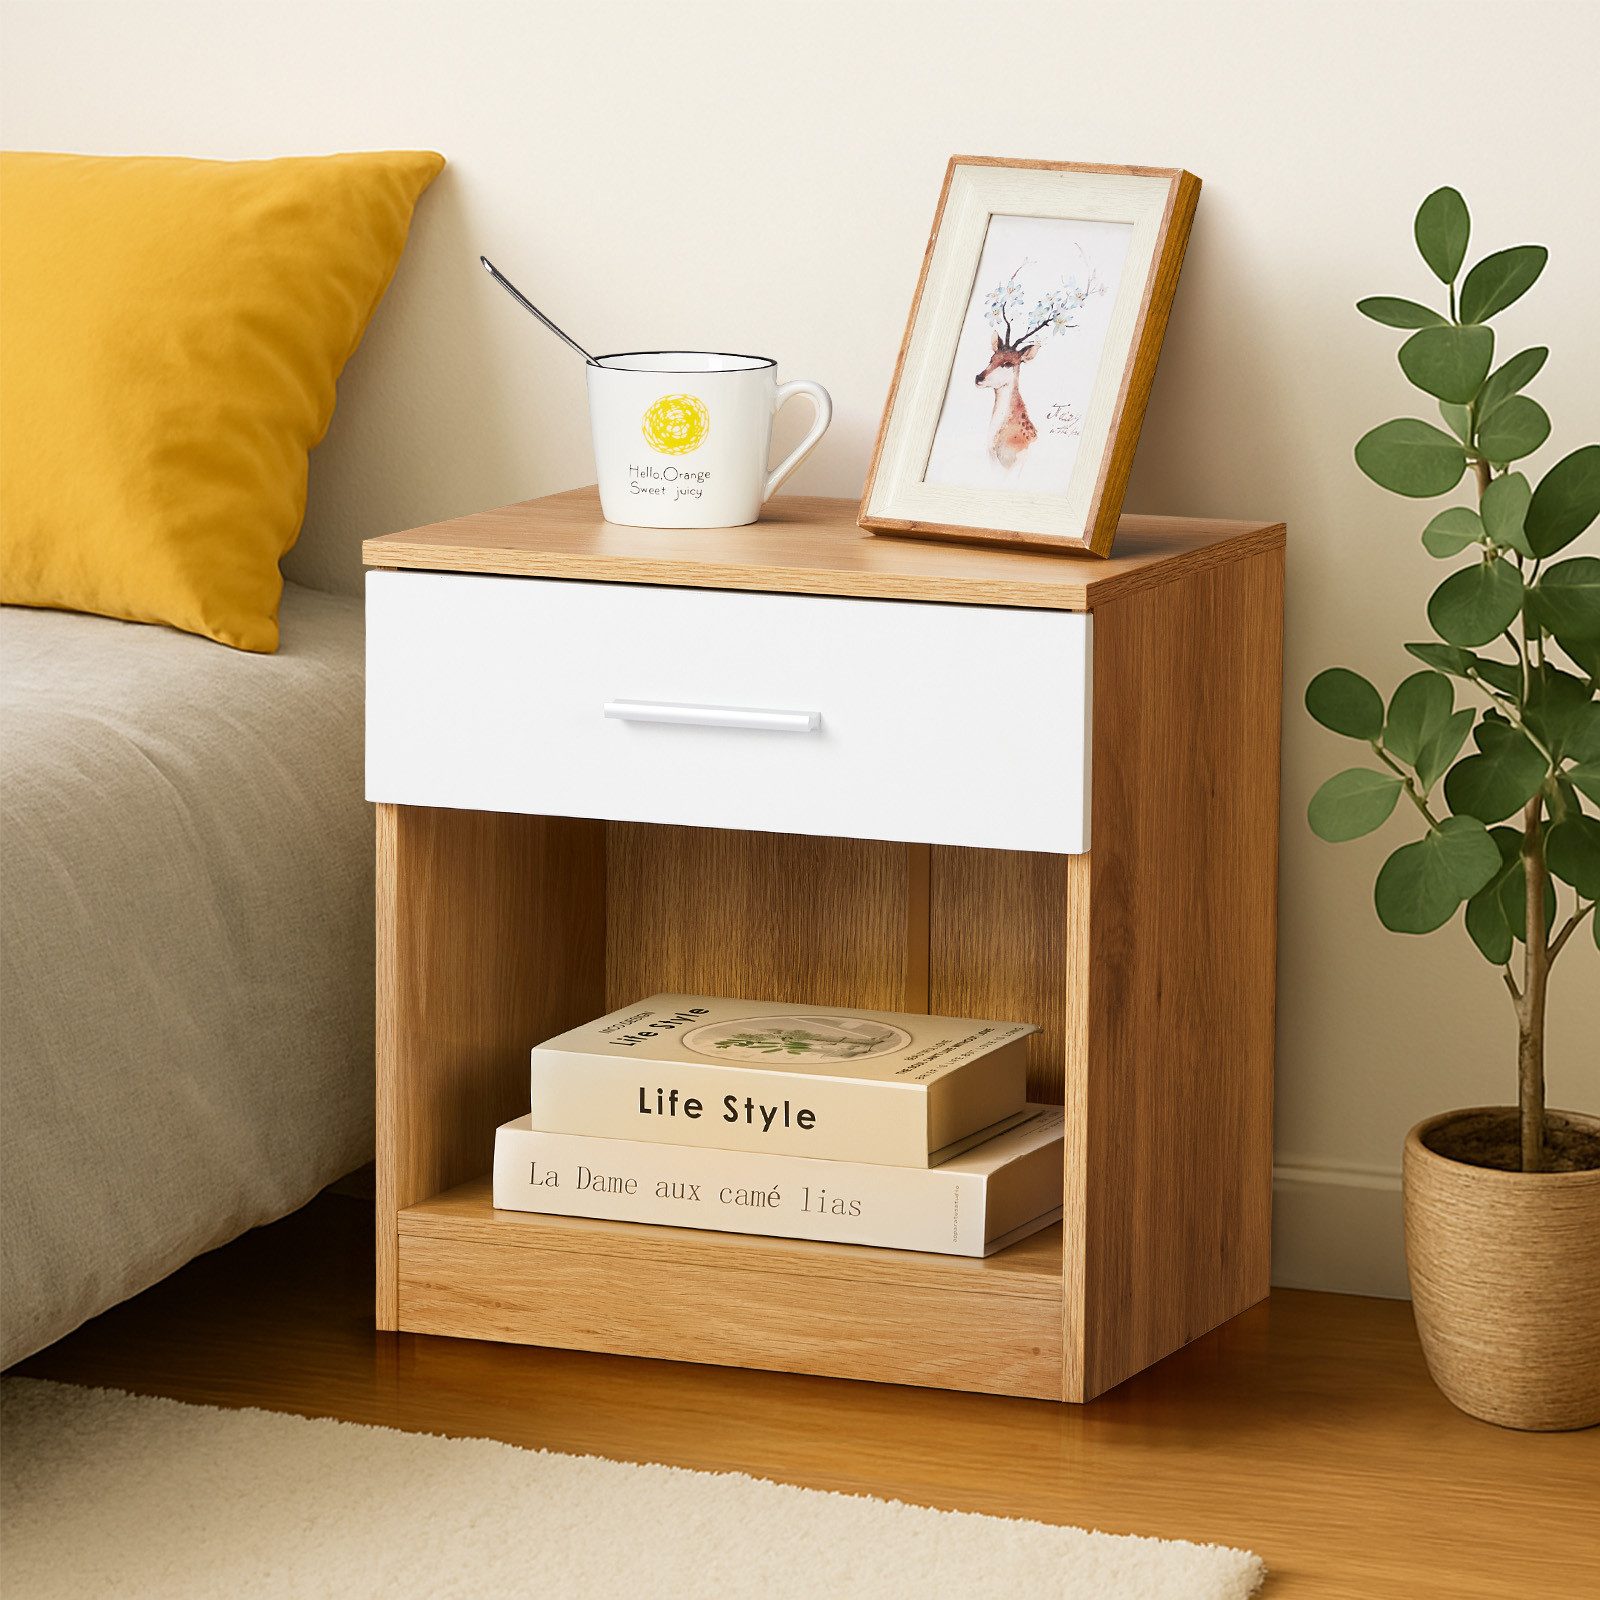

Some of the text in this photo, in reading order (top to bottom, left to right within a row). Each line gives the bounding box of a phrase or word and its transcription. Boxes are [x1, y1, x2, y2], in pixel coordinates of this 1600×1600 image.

[629, 480, 703, 501] Sweet juicy
[609, 1008, 710, 1047] Life Style
[638, 1086, 817, 1133] Life Style
[528, 1161, 862, 1218] La Dame aux camé lias
